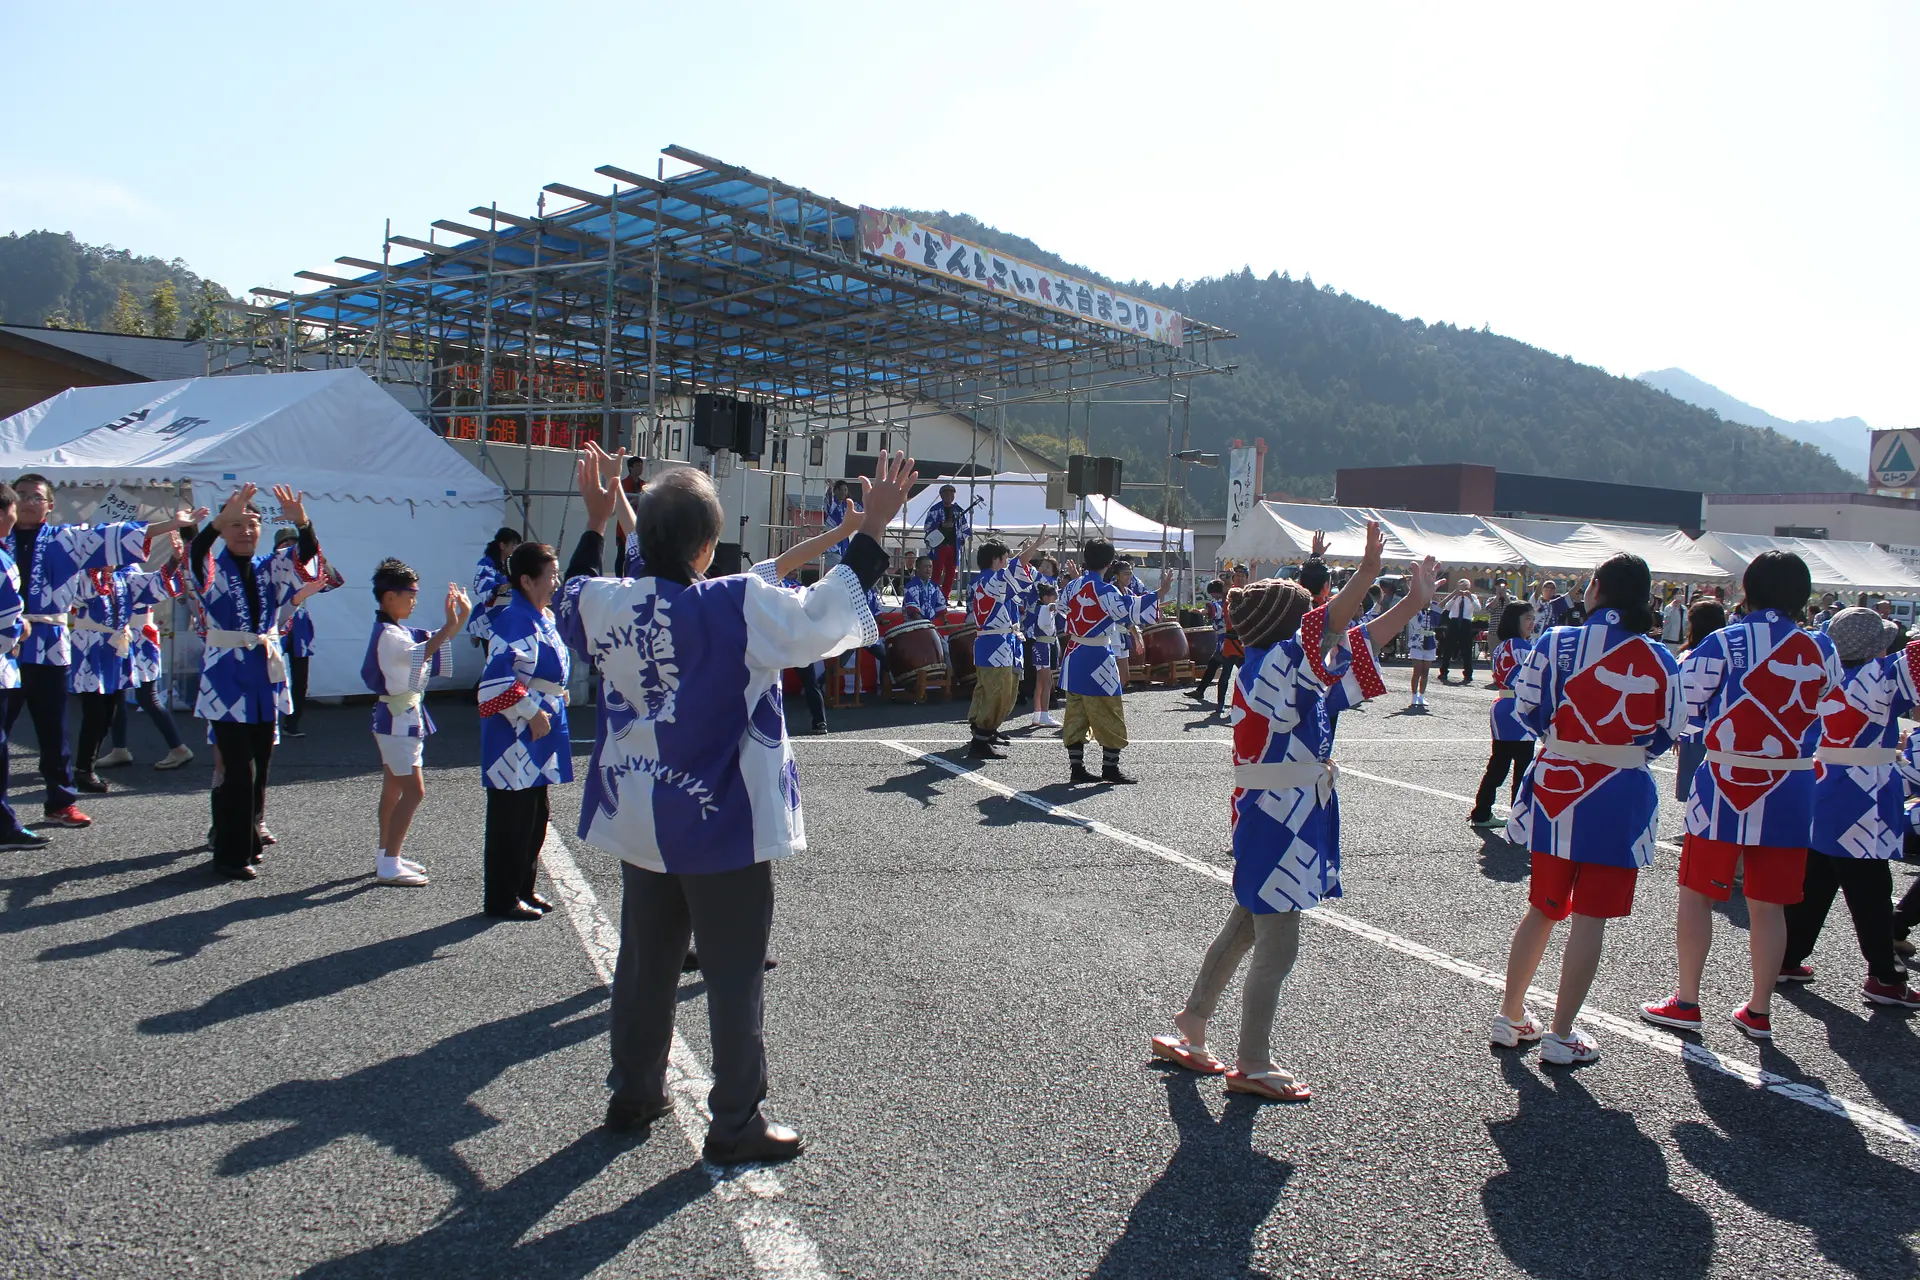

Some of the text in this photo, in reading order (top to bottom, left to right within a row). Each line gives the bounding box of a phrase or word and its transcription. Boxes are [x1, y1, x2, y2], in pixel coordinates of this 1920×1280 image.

[923, 231, 1149, 331] どんとこい 大台まつり
[1594, 663, 1659, 731] 大
[1768, 654, 1825, 714] 大
